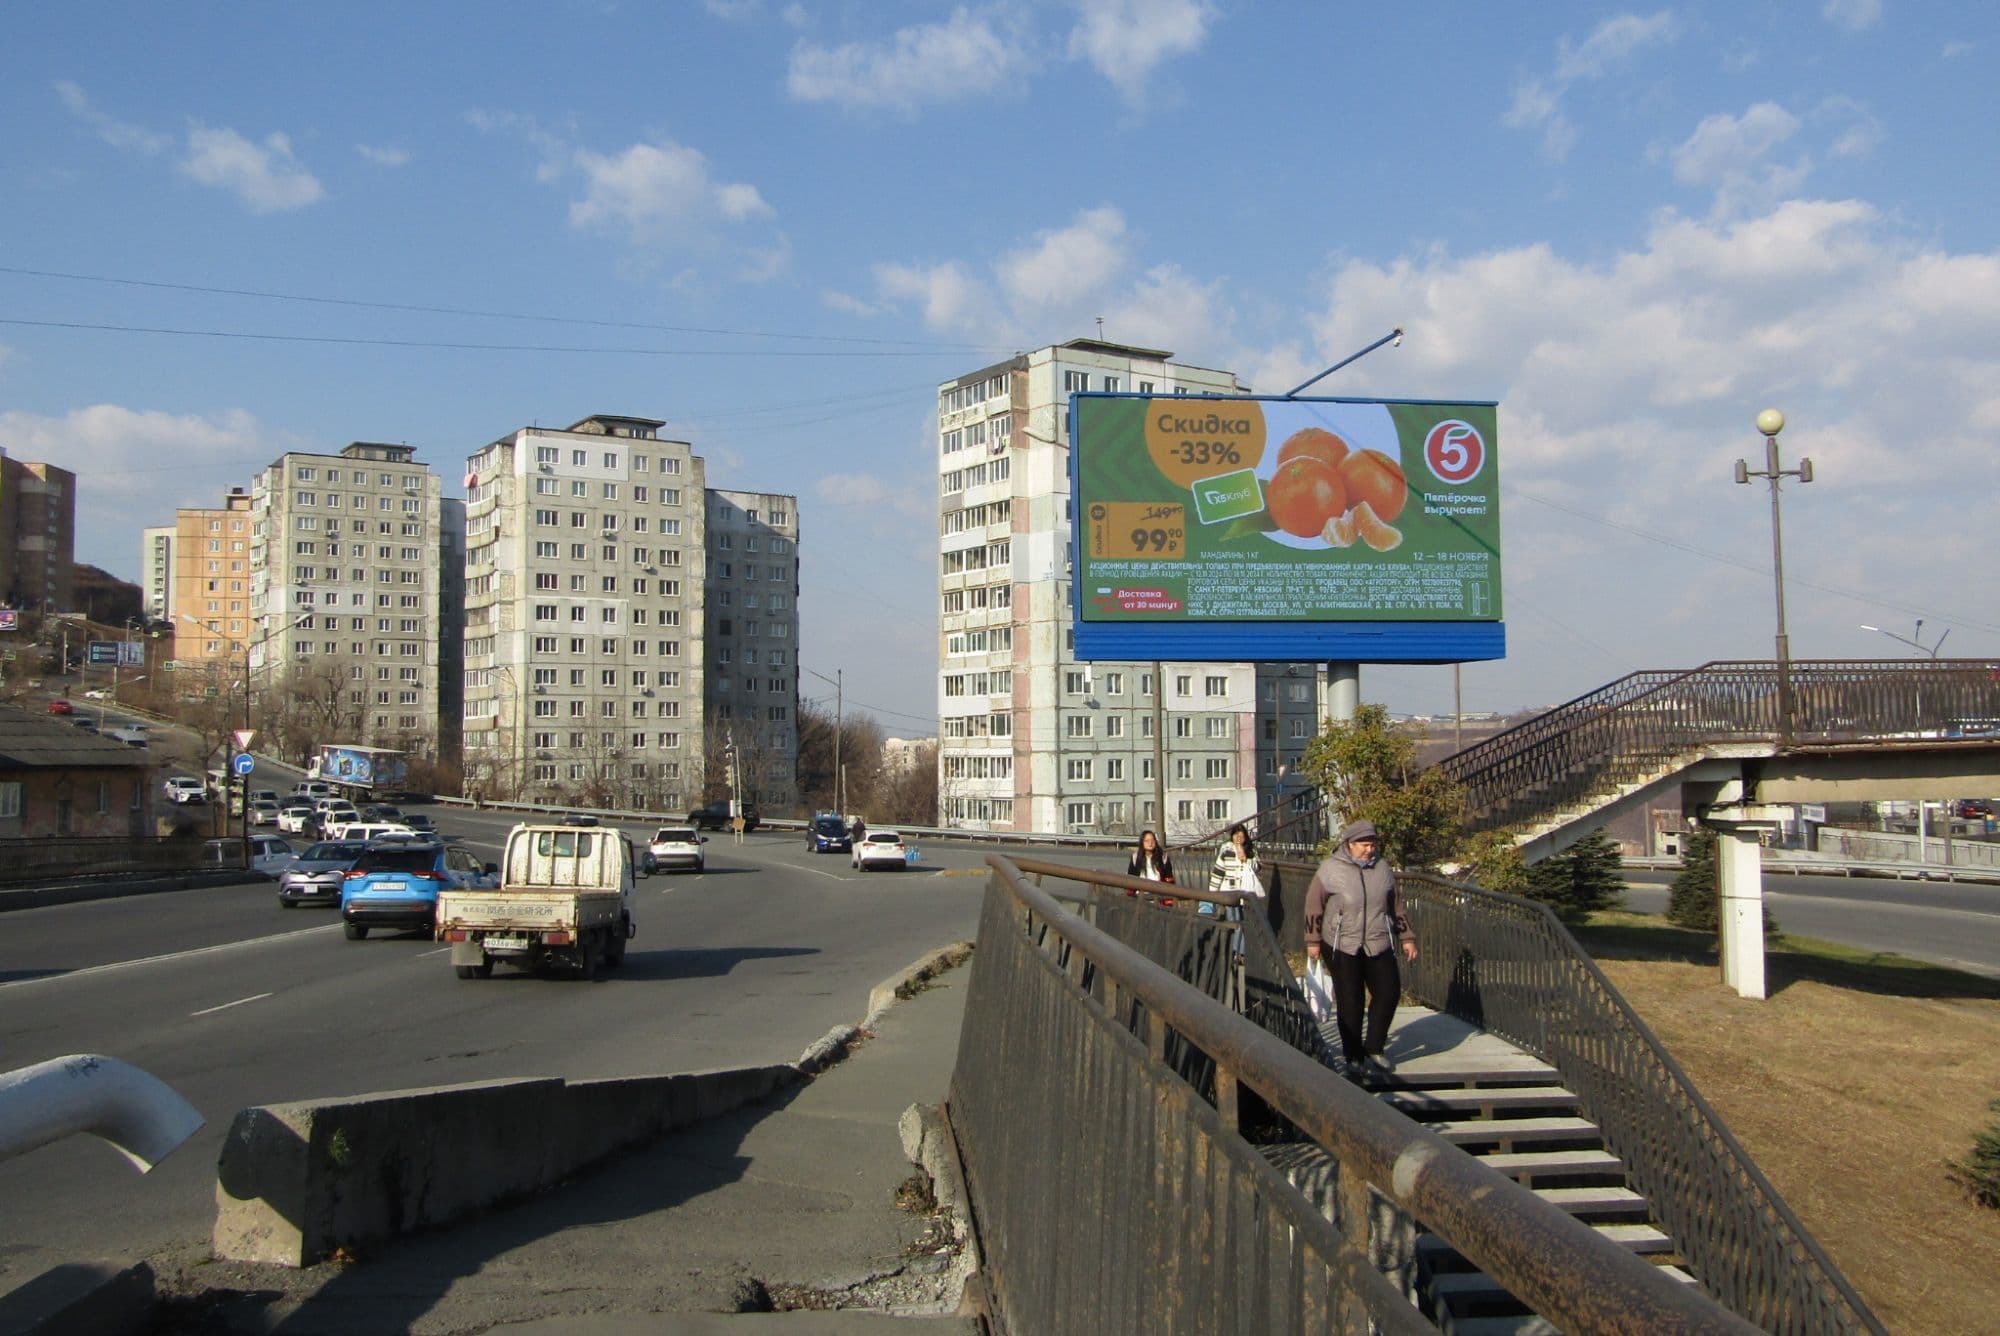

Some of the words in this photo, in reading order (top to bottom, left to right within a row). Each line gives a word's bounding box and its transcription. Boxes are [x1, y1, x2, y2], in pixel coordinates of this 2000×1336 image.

[1158, 414, 1251, 434] Скидка
[1170, 441, 1242, 465] -33%
[1424, 492, 1487, 504] Пятёрочка
[1424, 505, 1487, 517] выручает!
[1413, 552, 1423, 560] 12
[1438, 552, 1447, 560] 18
[1450, 552, 1489, 560] НОЯБРЯ
[1118, 590, 1162, 599] Доставка
[1149, 602, 1178, 611] минут
